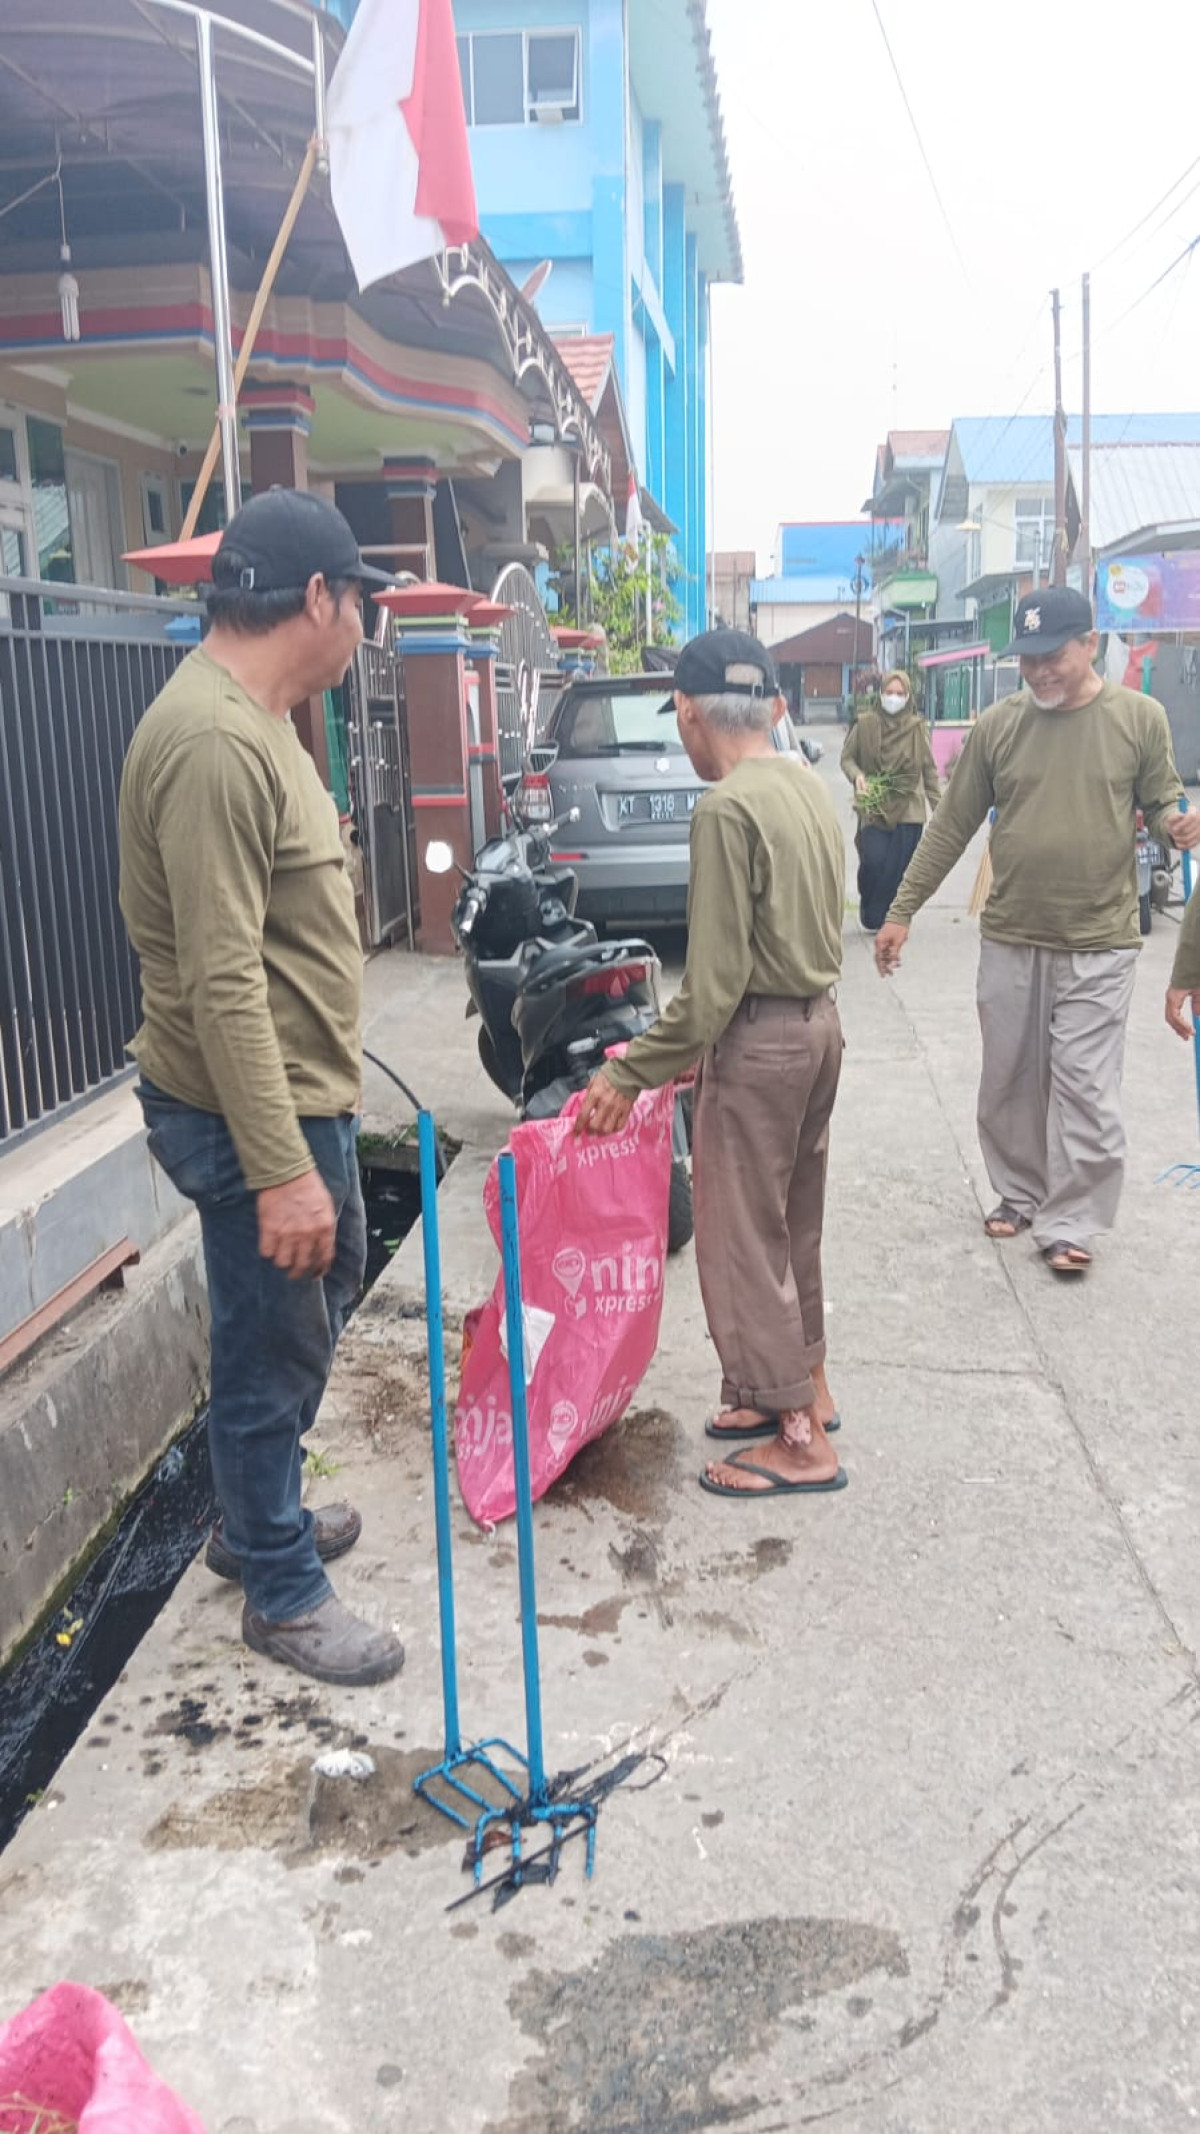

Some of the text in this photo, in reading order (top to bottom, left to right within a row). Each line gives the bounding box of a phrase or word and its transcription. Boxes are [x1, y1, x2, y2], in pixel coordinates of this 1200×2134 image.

[619, 795, 635, 814] KT
[576, 1138, 637, 1168] xpress
[591, 1241, 660, 1292] nin
